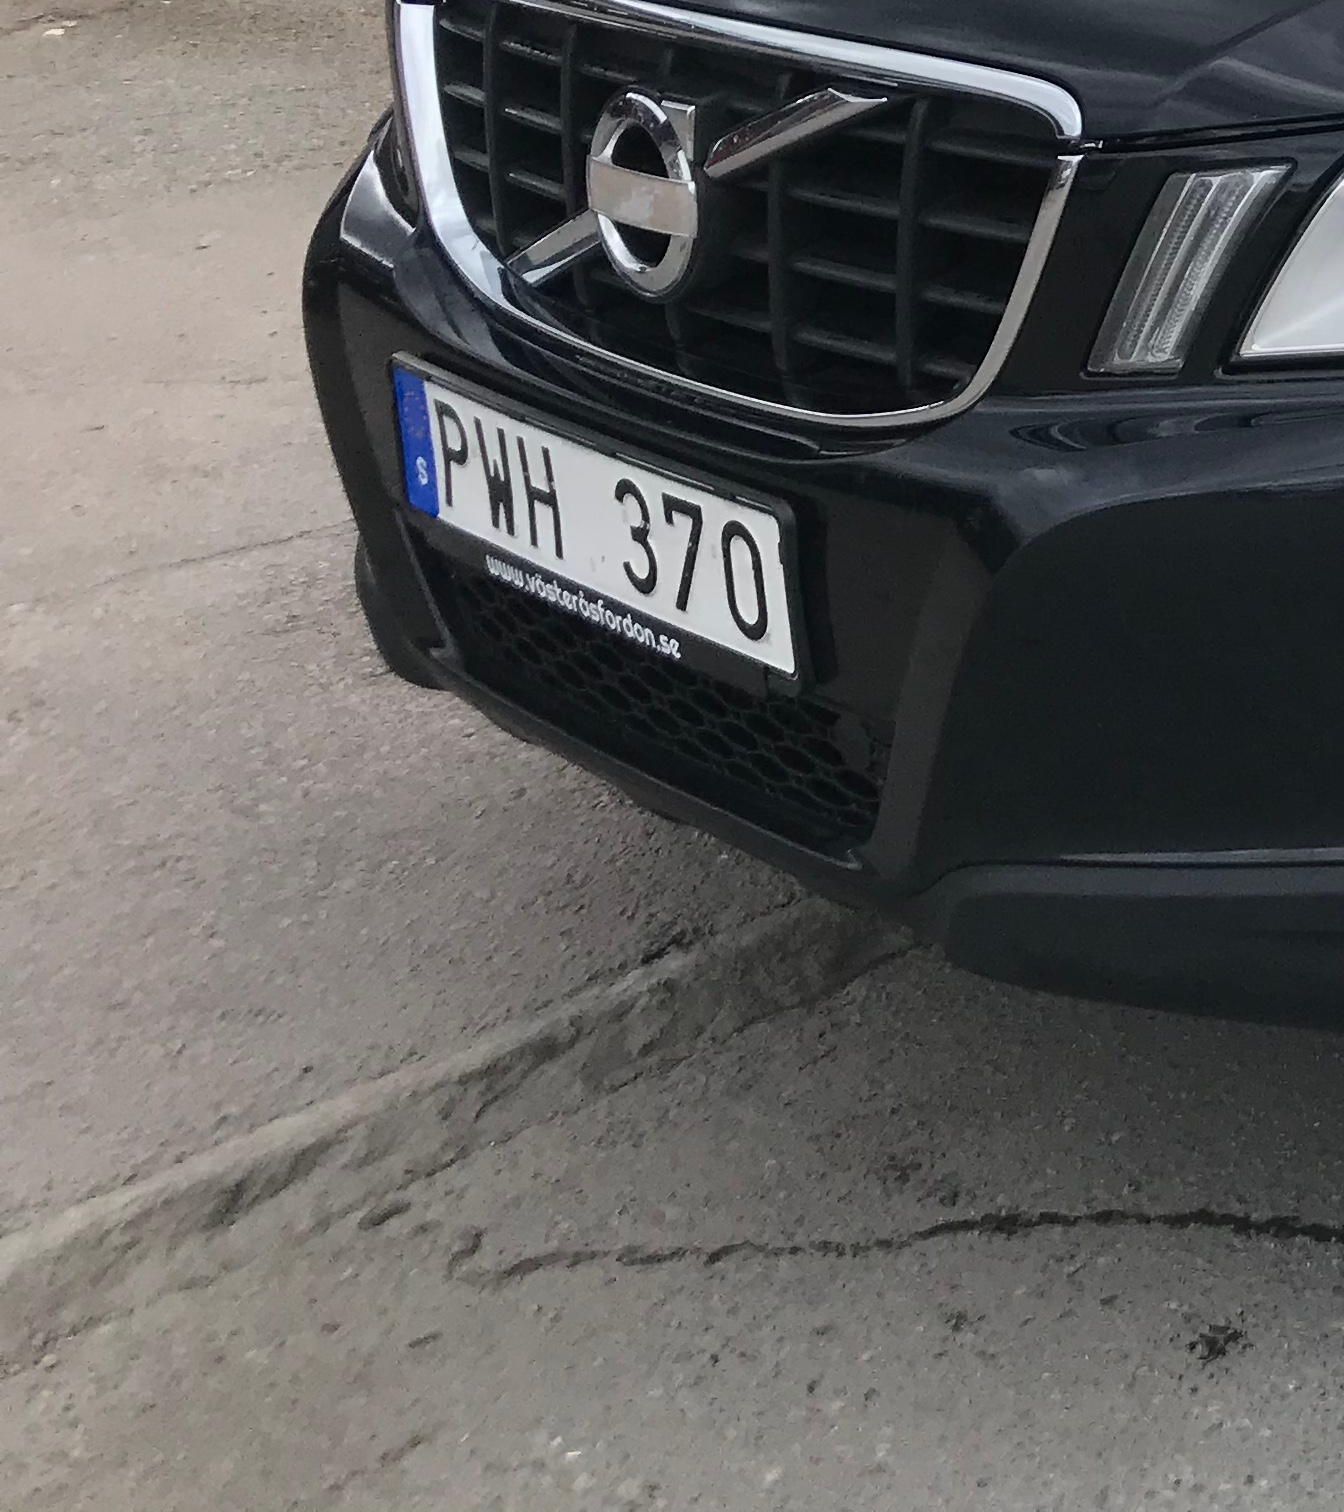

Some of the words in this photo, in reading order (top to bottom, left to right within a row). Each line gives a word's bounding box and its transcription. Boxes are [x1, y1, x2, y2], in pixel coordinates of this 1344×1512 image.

[415, 455, 429, 486] S
[433, 398, 564, 560] PWH
[615, 478, 768, 642] 370
[484, 553, 682, 660] www.västeråsfordon.se
